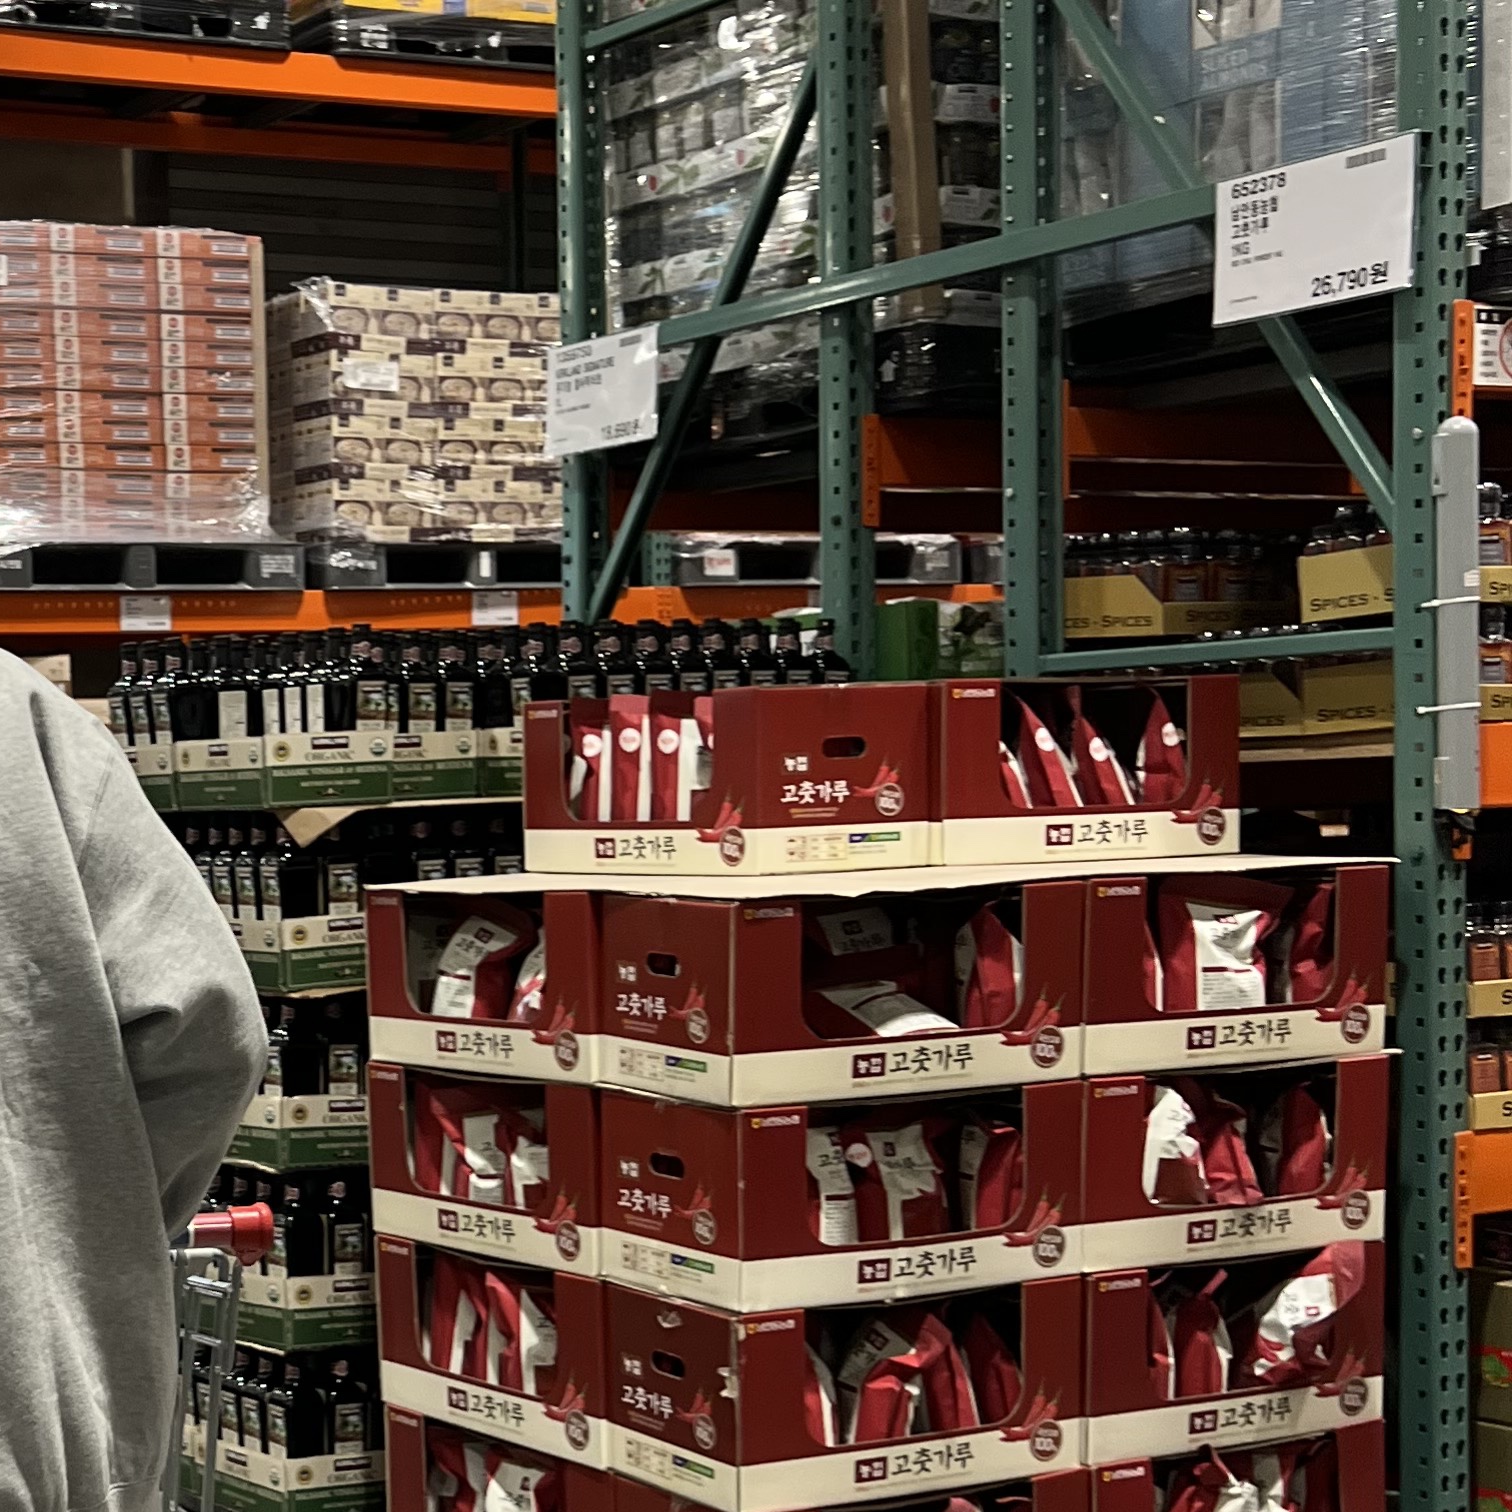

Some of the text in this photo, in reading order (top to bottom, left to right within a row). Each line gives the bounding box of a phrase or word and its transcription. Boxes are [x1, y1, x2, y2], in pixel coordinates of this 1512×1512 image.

[1231, 171, 1286, 200] 652378
[1311, 260, 1390, 299] 26,790원
[1311, 593, 1370, 612] SPICES
[1102, 615, 1153, 628] SPICES
[1240, 714, 1285, 727] PICES
[780, 780, 851, 804] 고춧가루
[1077, 818, 1149, 845] 고춧가루
[618, 835, 677, 860] 고춧가루
[616, 992, 667, 1020] 고춧가루
[459, 1031, 514, 1057] 고춧가루
[1218, 1019, 1292, 1047] 고춧가루
[889, 1043, 974, 1075] 고춧가루
[617, 1188, 672, 1218] 고춧가루
[461, 1213, 516, 1242] 고춧가루
[1219, 1210, 1292, 1239] 고춧가루
[894, 1246, 977, 1279] 고춧가루
[470, 1392, 525, 1426] 고춧가루
[621, 1384, 674, 1419] 고춧가루
[1220, 1397, 1292, 1428] 고춧가루
[891, 1442, 975, 1477] 고춧가루
